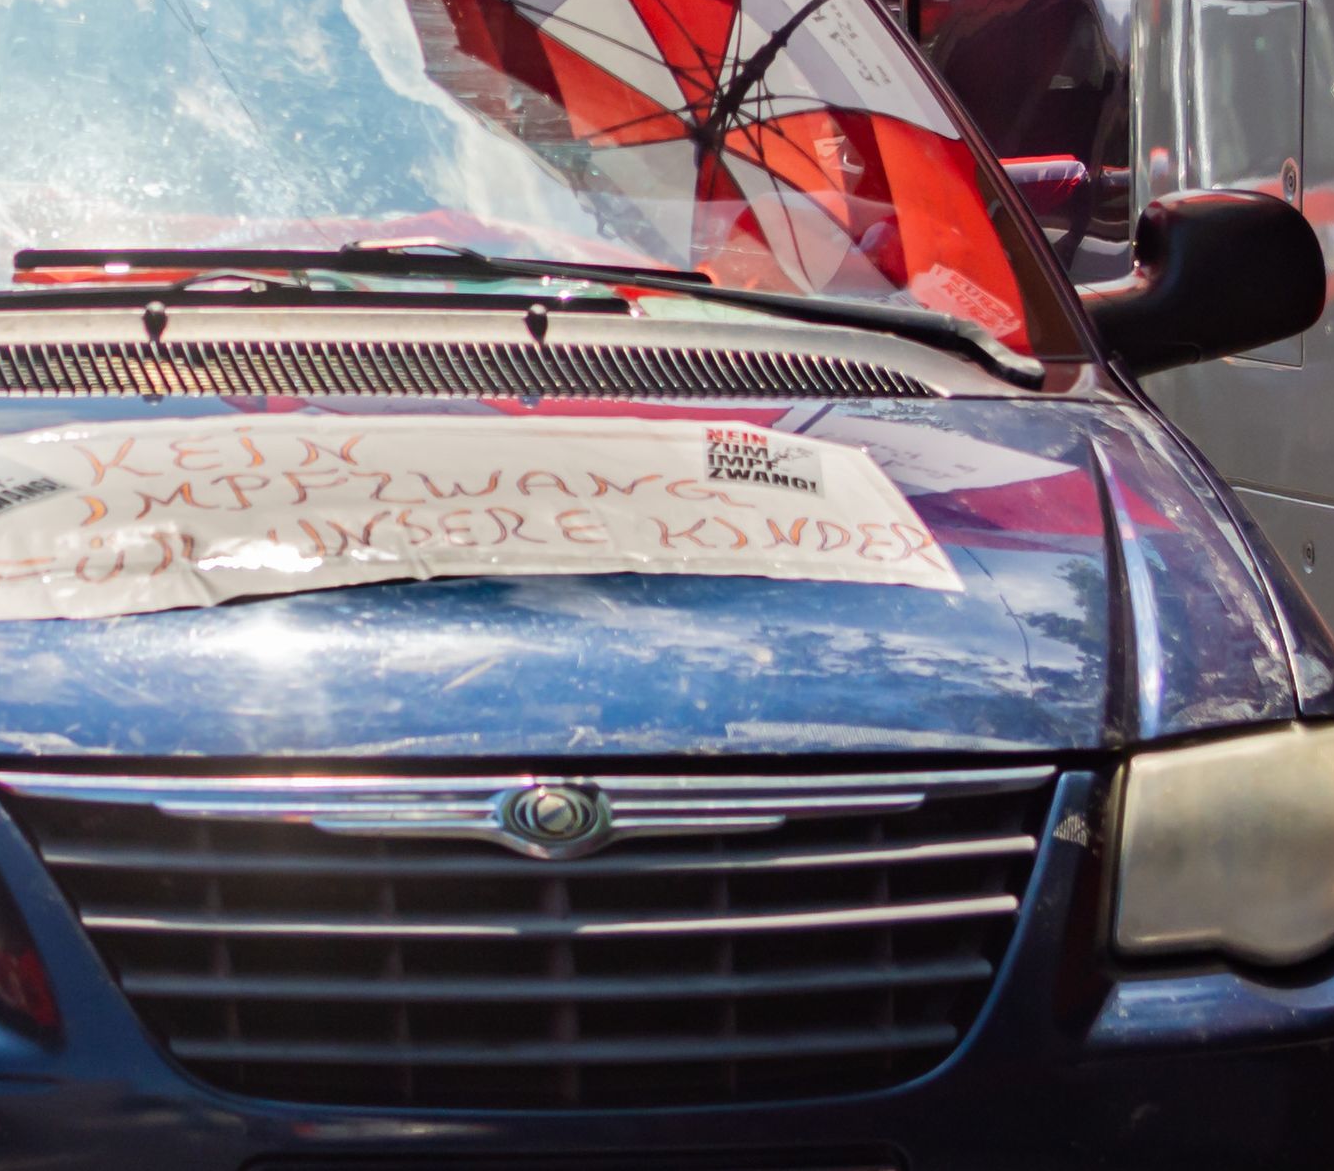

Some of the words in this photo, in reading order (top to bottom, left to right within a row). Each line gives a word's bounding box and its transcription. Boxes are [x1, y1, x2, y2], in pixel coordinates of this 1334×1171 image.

[73, 427, 367, 486] KEIN
[707, 428, 767, 445] NEIN
[708, 442, 769, 459] ZUM
[76, 467, 756, 527] IMPFZWANG
[708, 468, 817, 493] ZWANG!
[653, 516, 946, 571] KINDER
